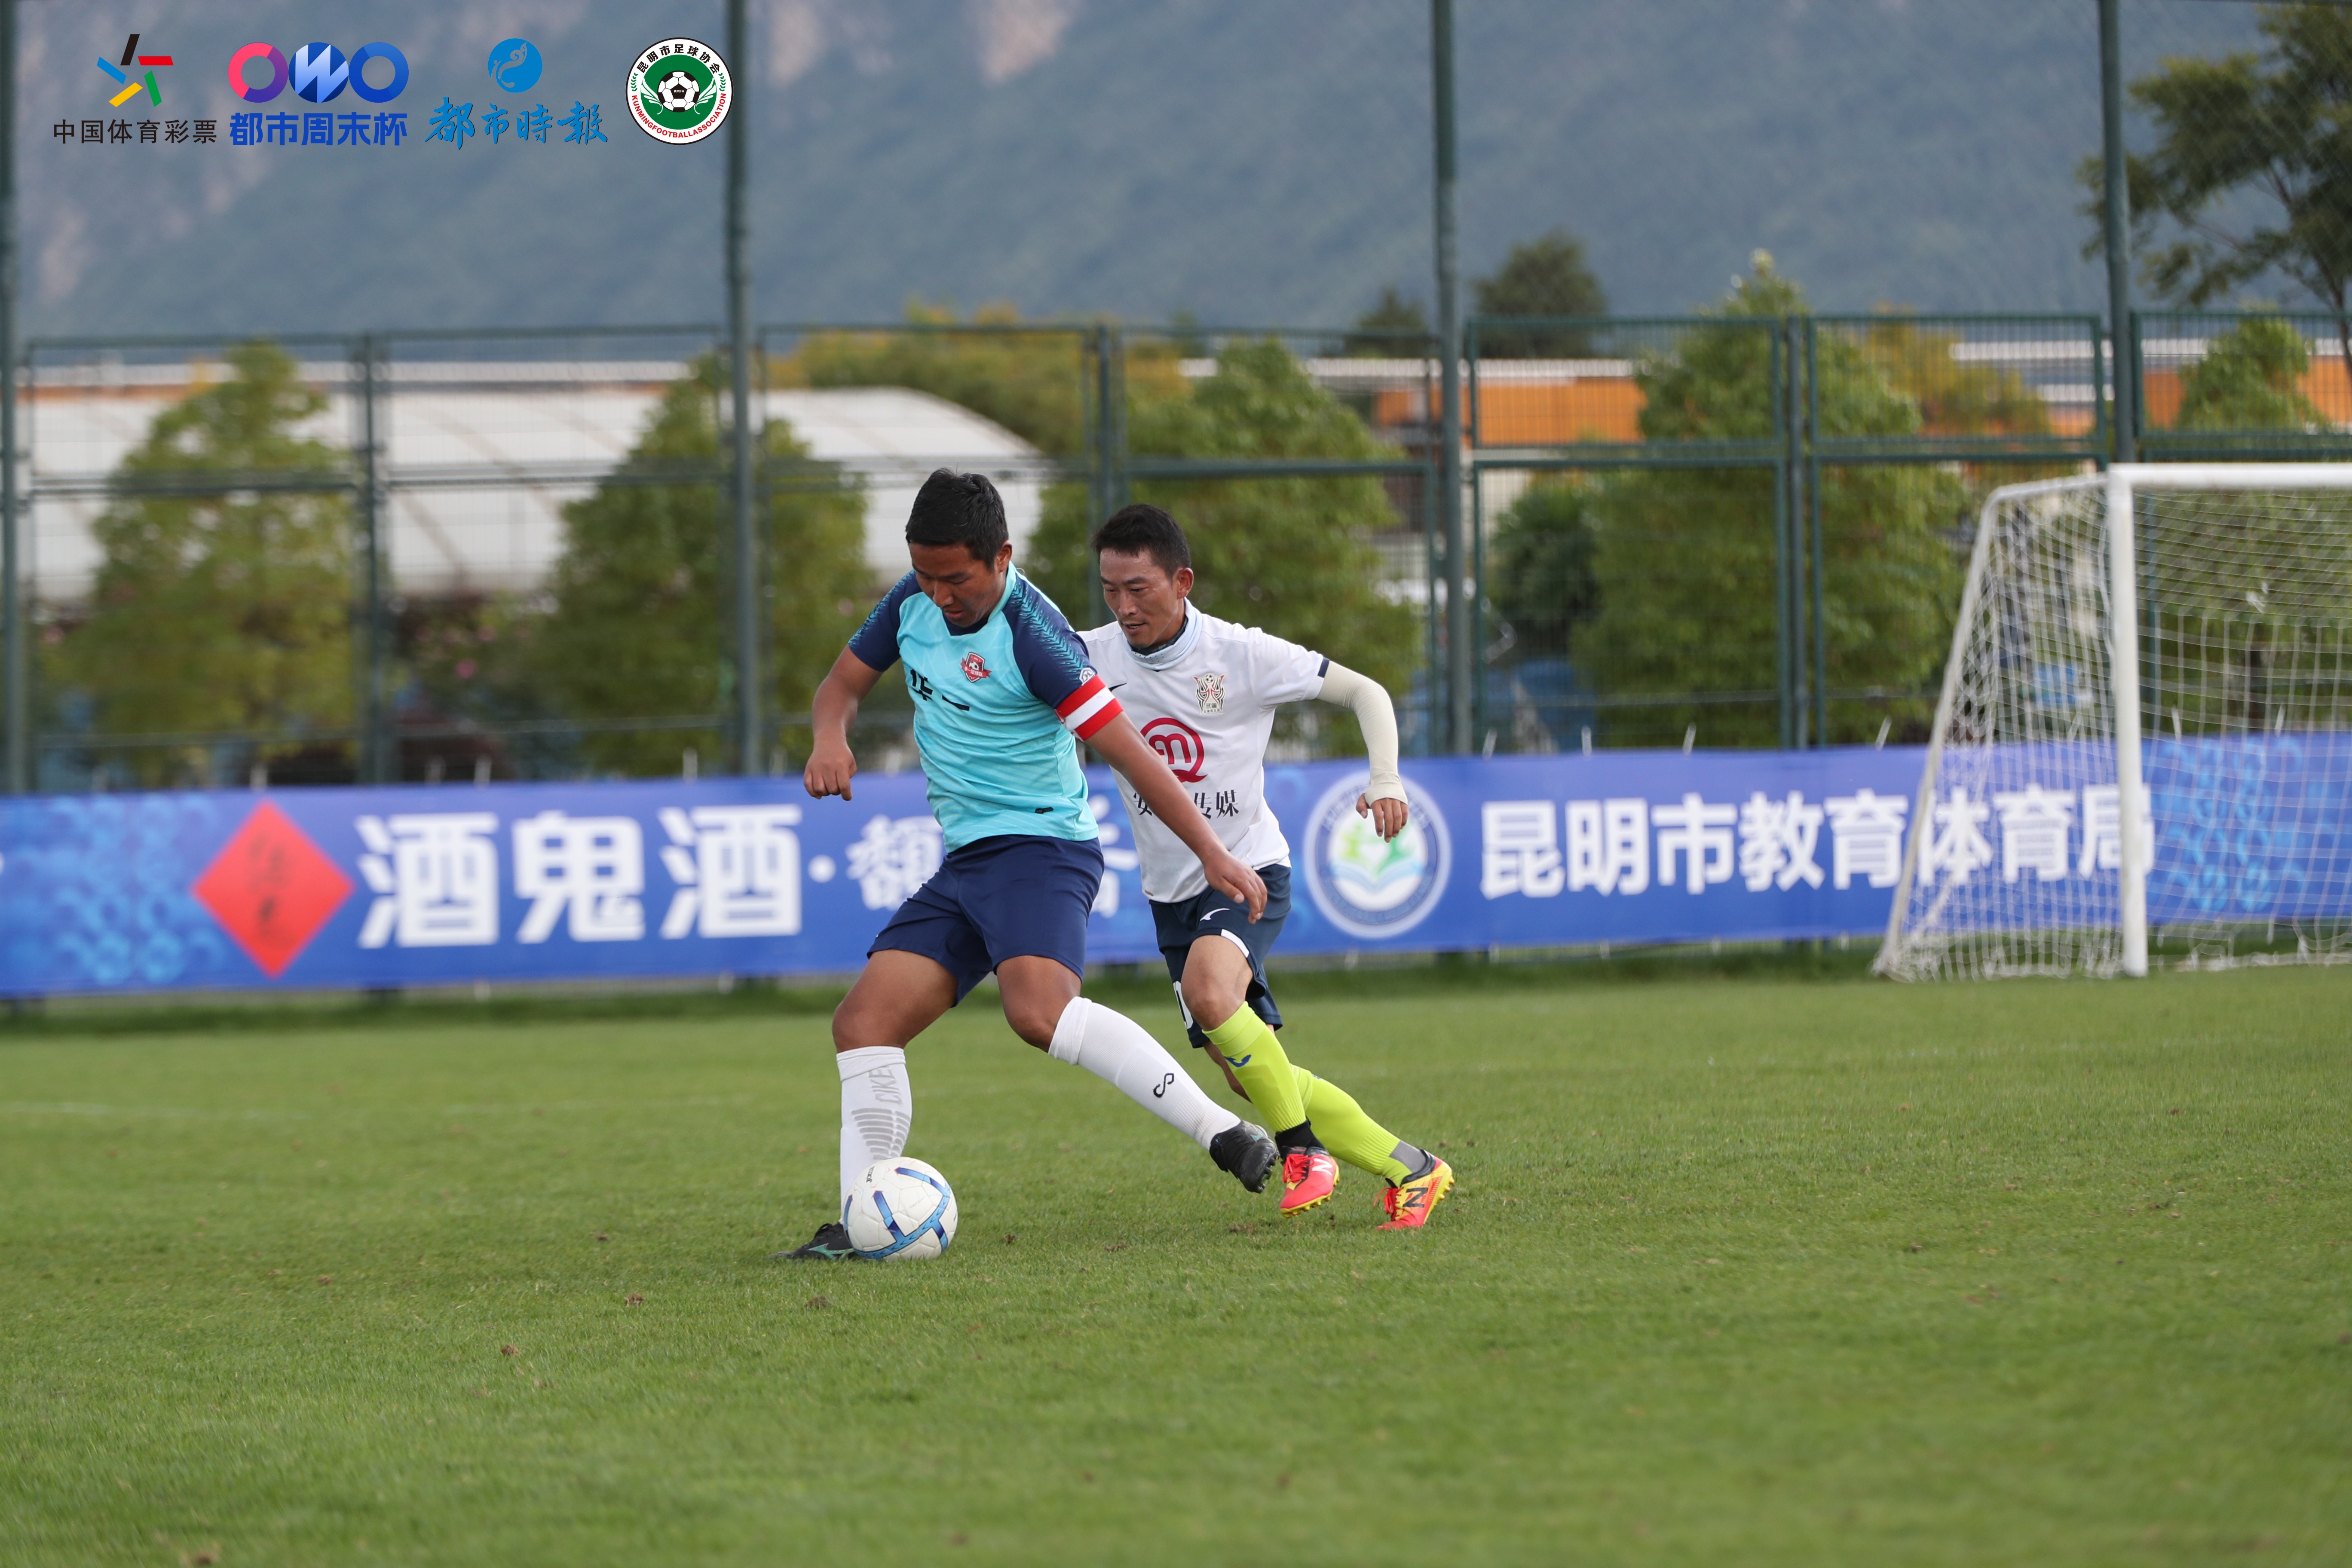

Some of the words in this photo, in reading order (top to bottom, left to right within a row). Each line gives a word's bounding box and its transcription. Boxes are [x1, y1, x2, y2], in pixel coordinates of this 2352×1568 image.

[1133, 789, 1240, 820] 安传媒
[1482, 783, 2155, 900] 昆明市教育体育局
[868, 1065, 903, 1106] CIKE
